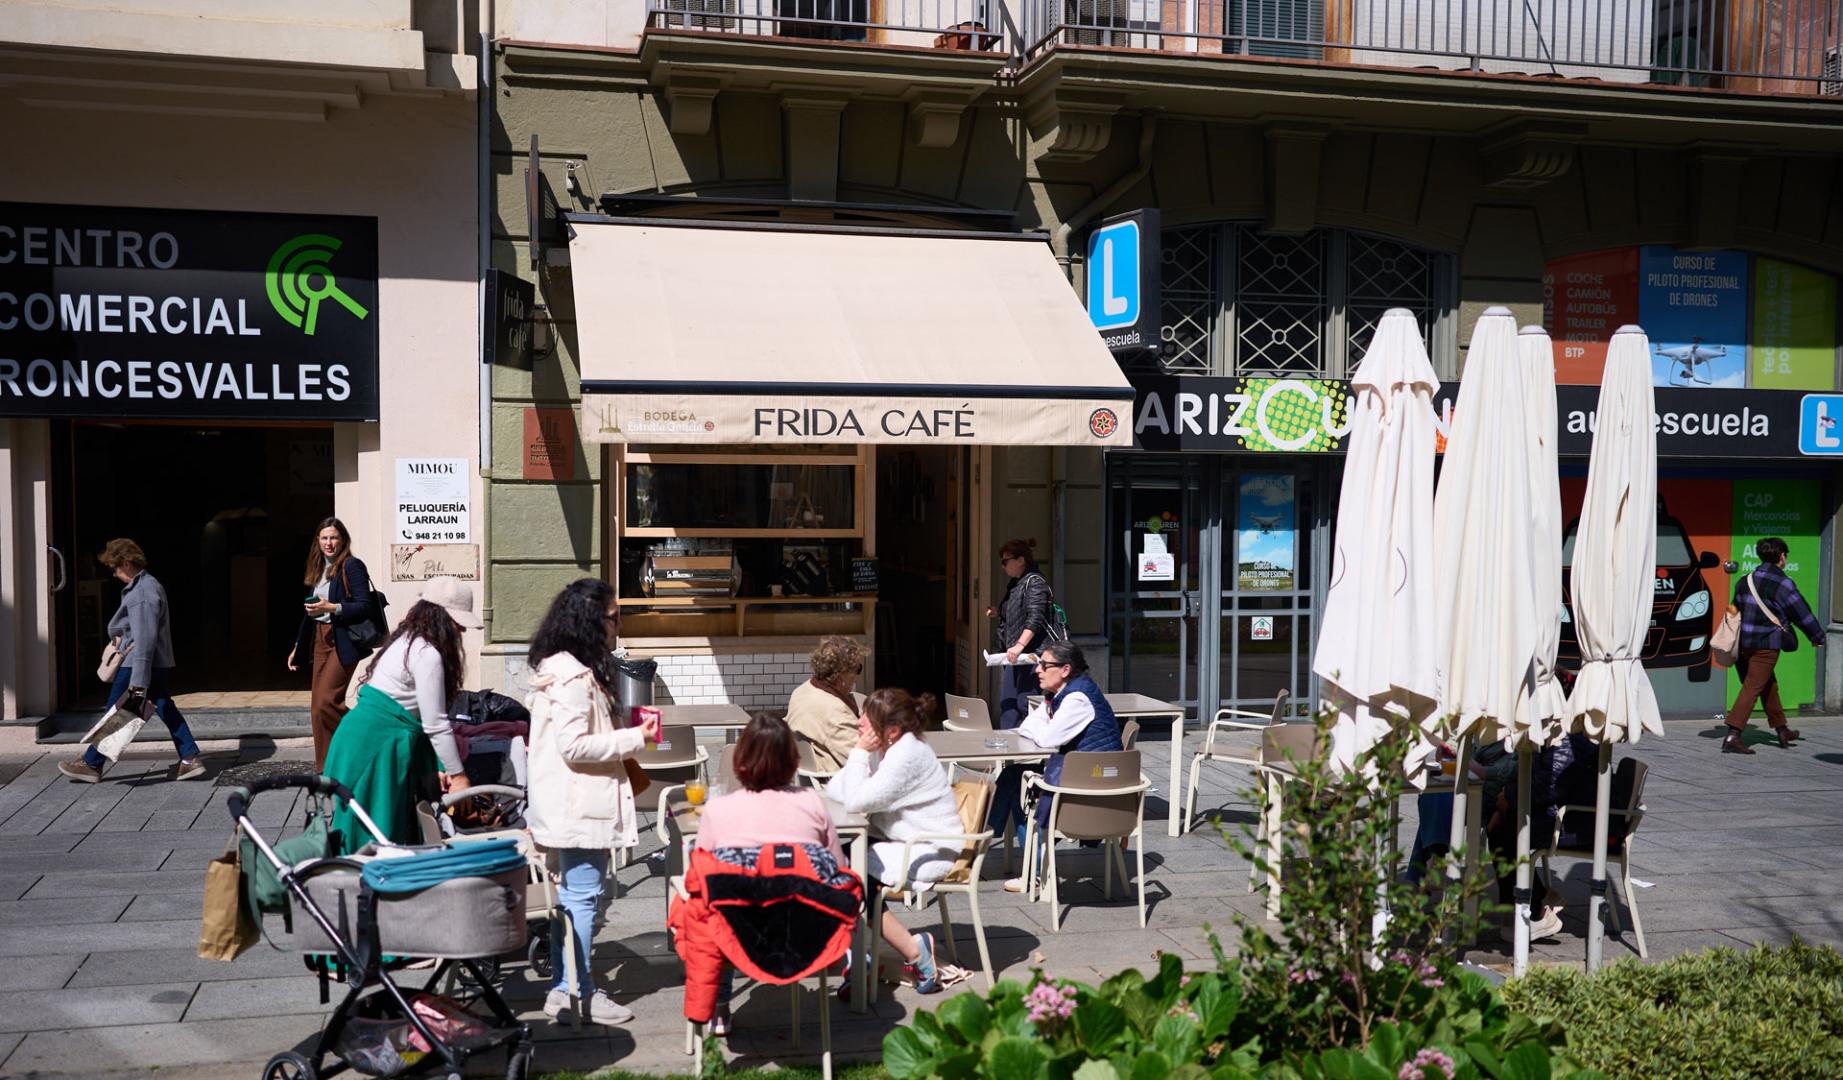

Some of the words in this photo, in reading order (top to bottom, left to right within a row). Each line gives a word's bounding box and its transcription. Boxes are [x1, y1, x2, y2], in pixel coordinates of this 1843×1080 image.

[0, 225, 179, 269] CENTRO
[1673, 256, 1701, 270] CURSO
[1704, 257, 1716, 270] DE
[1566, 272, 1604, 284] COCHE
[1648, 273, 1679, 288] PILOTO
[1680, 275, 1740, 290] PROFESIONAL
[1566, 287, 1612, 300] CAMIÓN
[1669, 293, 1681, 305] DE
[1683, 294, 1718, 307] DRONES
[0, 291, 261, 336] COMERCIAL
[1566, 301, 1617, 314] AUTOBÚS
[1566, 317, 1606, 329] TRAILER
[1103, 330, 1140, 347] escuela
[1566, 333, 1599, 343] MOTO
[1564, 347, 1585, 358] BTP
[0, 359, 351, 401] RONCESVALLES
[644, 411, 696, 422] BODEGA
[754, 408, 865, 437] FRIDA
[880, 402, 975, 437] CAFÉ
[1134, 380, 1451, 450] ARIZCUN
[1566, 406, 1769, 437] ascuela
[399, 501, 467, 513] PELUQUERÍA
[1743, 493, 1774, 508] CAP
[407, 515, 458, 524] LARRAUN
[396, 572, 415, 580] UÑAS
